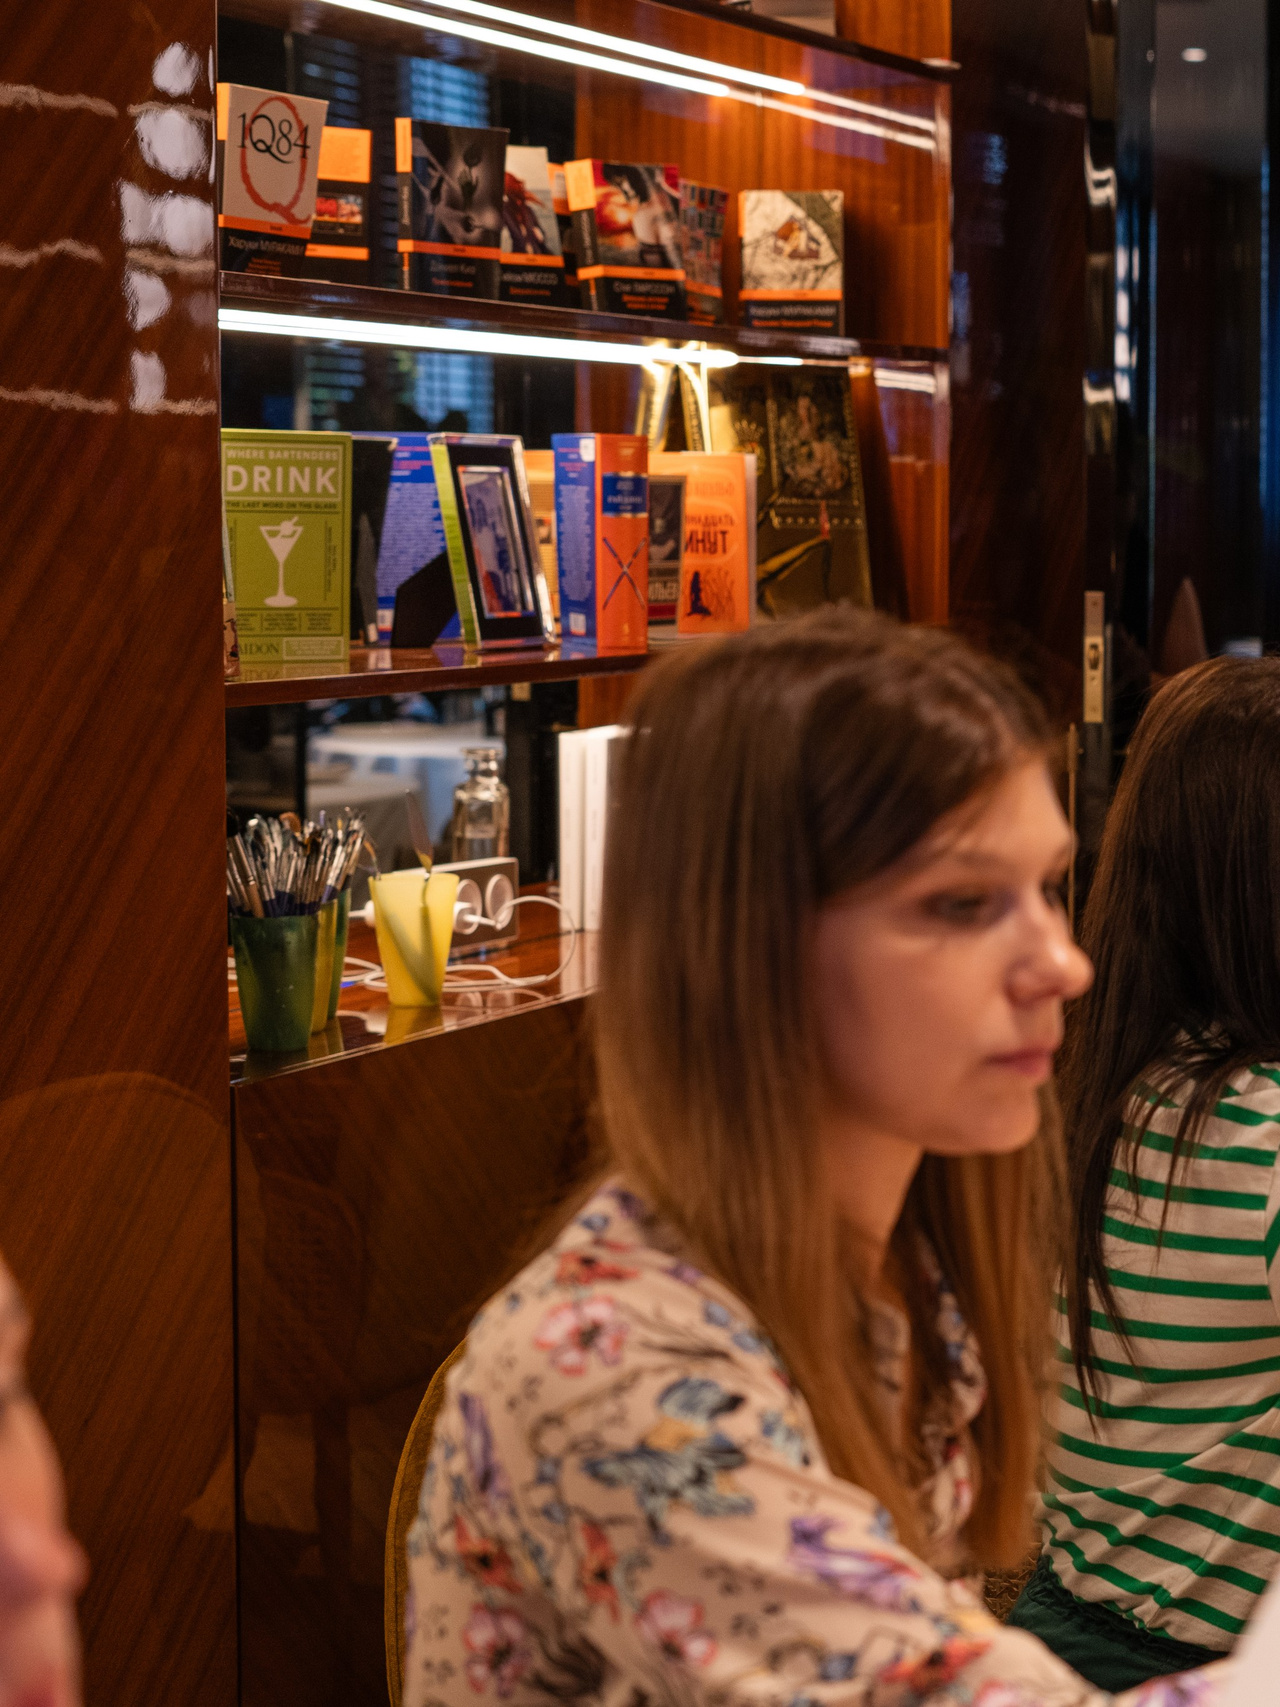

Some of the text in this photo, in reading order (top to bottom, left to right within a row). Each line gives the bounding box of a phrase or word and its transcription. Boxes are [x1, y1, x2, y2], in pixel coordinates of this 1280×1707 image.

[237, 112, 310, 164] 1Q84
[226, 449, 338, 461] WHERE BARTENDERS
[226, 464, 338, 494] DRINK
[684, 530, 728, 556] ИНУТ
